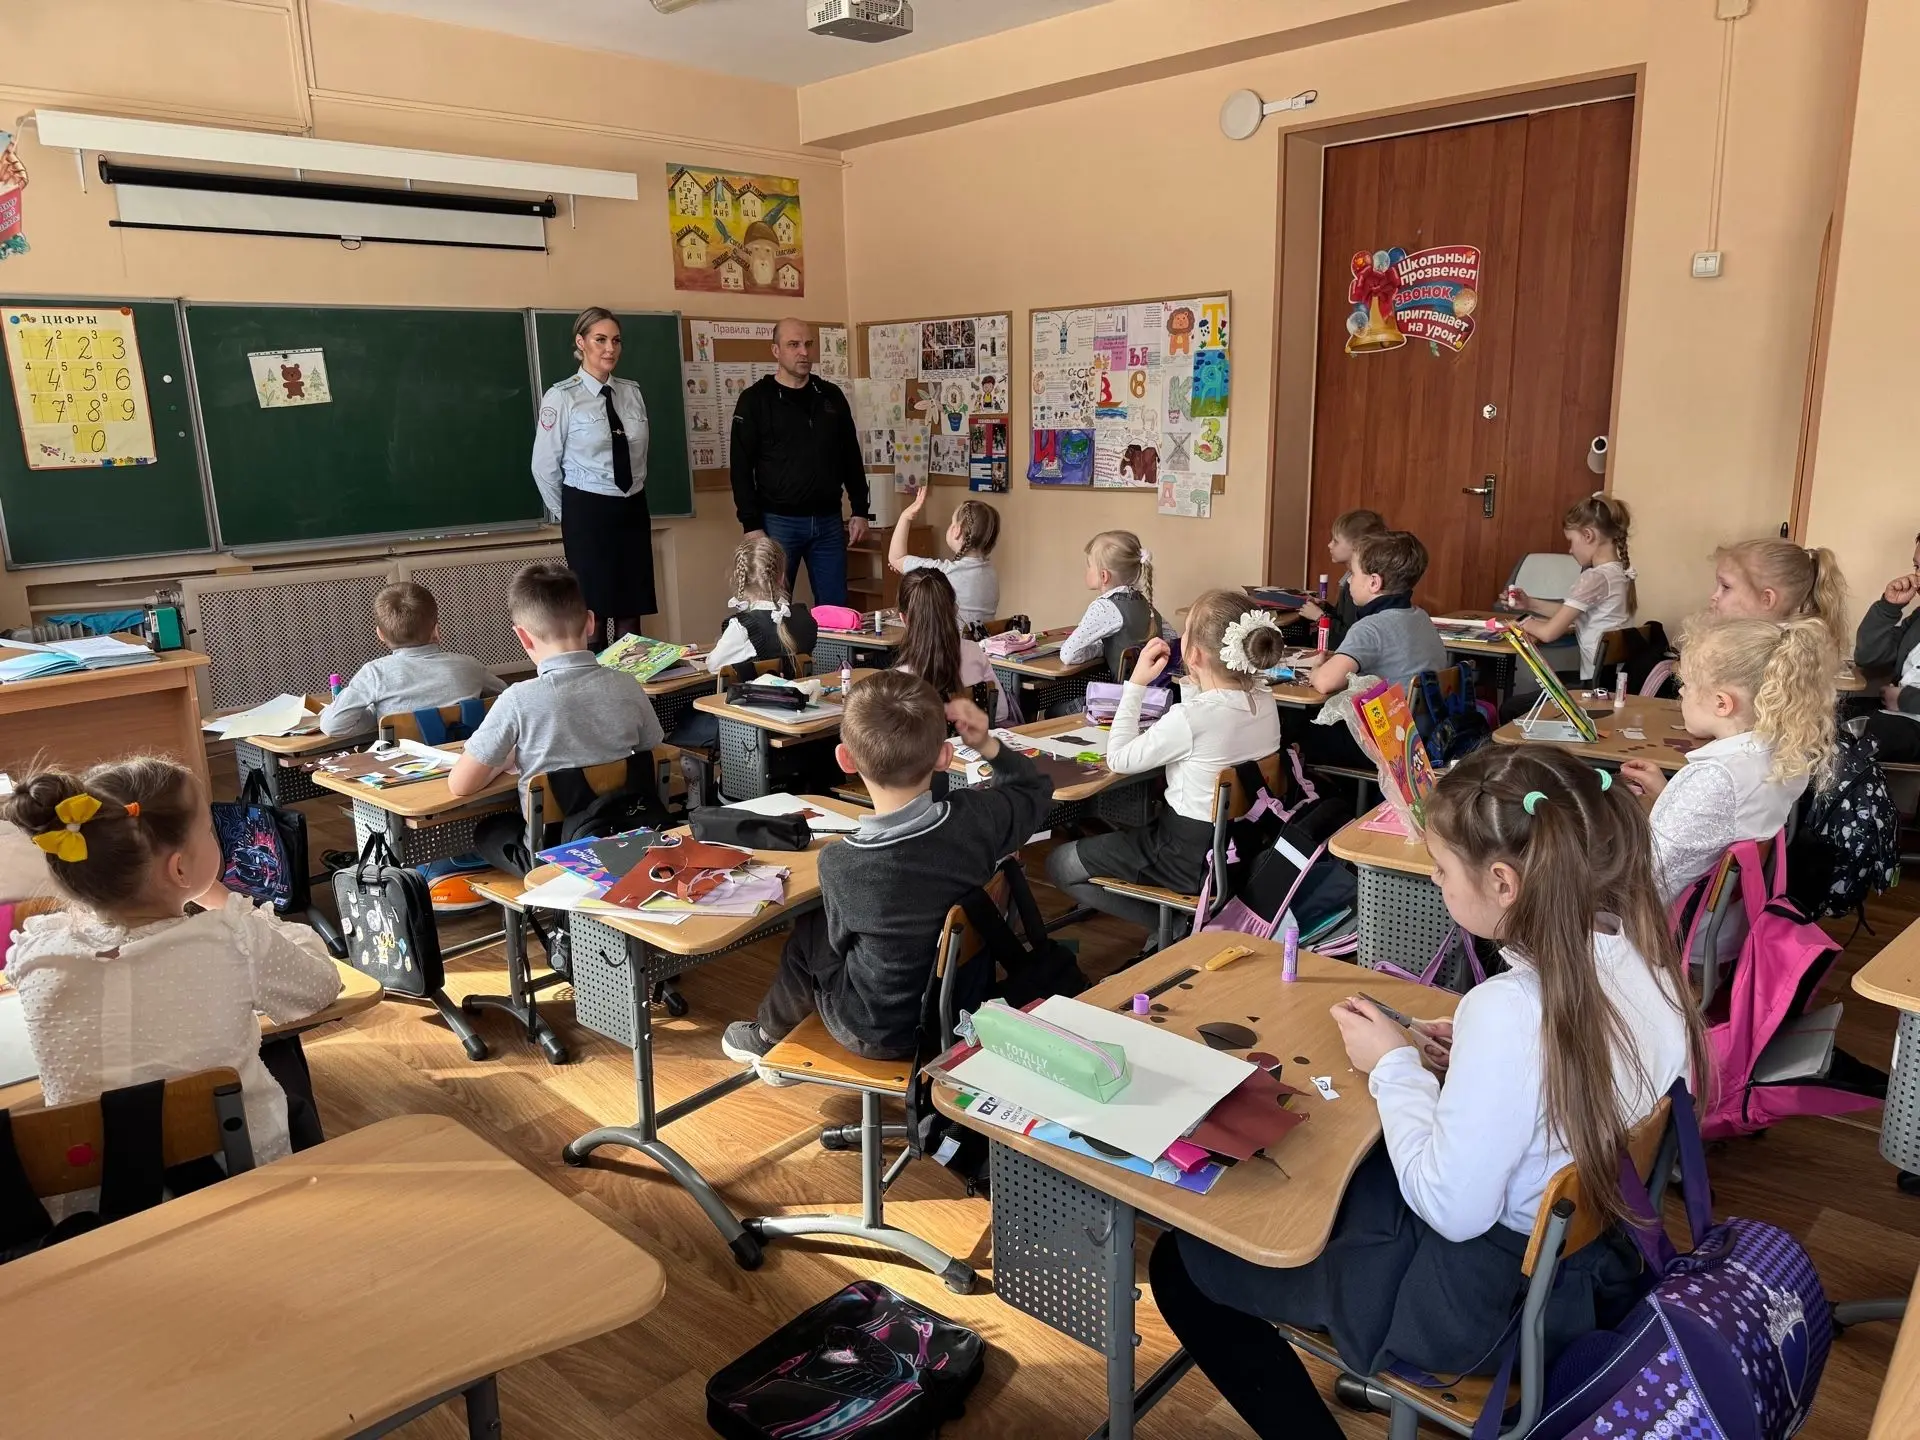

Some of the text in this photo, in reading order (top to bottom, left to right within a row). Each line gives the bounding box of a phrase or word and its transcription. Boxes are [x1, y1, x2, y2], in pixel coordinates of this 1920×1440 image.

[1397, 250, 1476, 276] Школьный
[1400, 266, 1477, 286] прозвенел
[42, 315, 98, 326] ЦИФРЫ
[713, 323, 751, 336] Правила
[1396, 310, 1469, 332] приглашает
[55, 330, 63, 340] 2
[91, 330, 98, 340] 3
[1408, 321, 1462, 345] на урок!
[44, 336, 126, 360] 1 2 3
[25, 362, 103, 371] 4 5 6
[48, 367, 131, 392] 4 5 6
[31, 393, 108, 404] 7 8 9
[52, 398, 136, 423] 7 8 9
[91, 429, 106, 453] 0
[1004, 1041, 1048, 1069] TOTALLY
